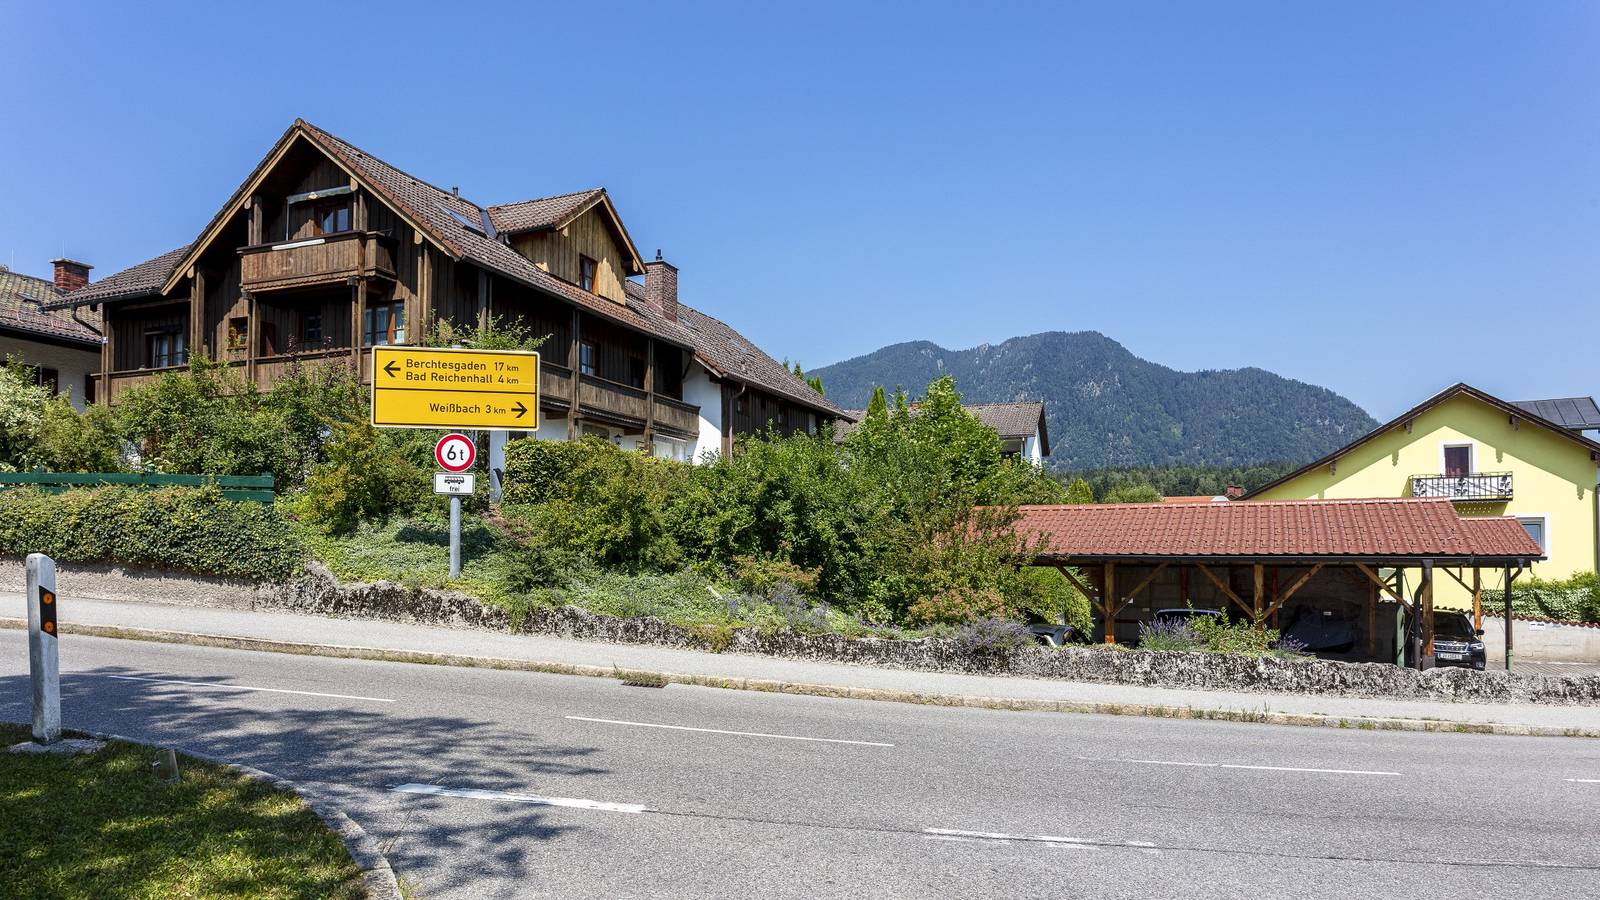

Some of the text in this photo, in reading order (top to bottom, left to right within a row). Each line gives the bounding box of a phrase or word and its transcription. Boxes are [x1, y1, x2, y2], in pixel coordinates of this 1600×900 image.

[406, 359, 519, 372] Berchtesgaden 17 km
[406, 372, 519, 385] Bad Reichenhall 4 km
[430, 403, 506, 414] Weißbach 3 km
[447, 445, 464, 461] 6 t
